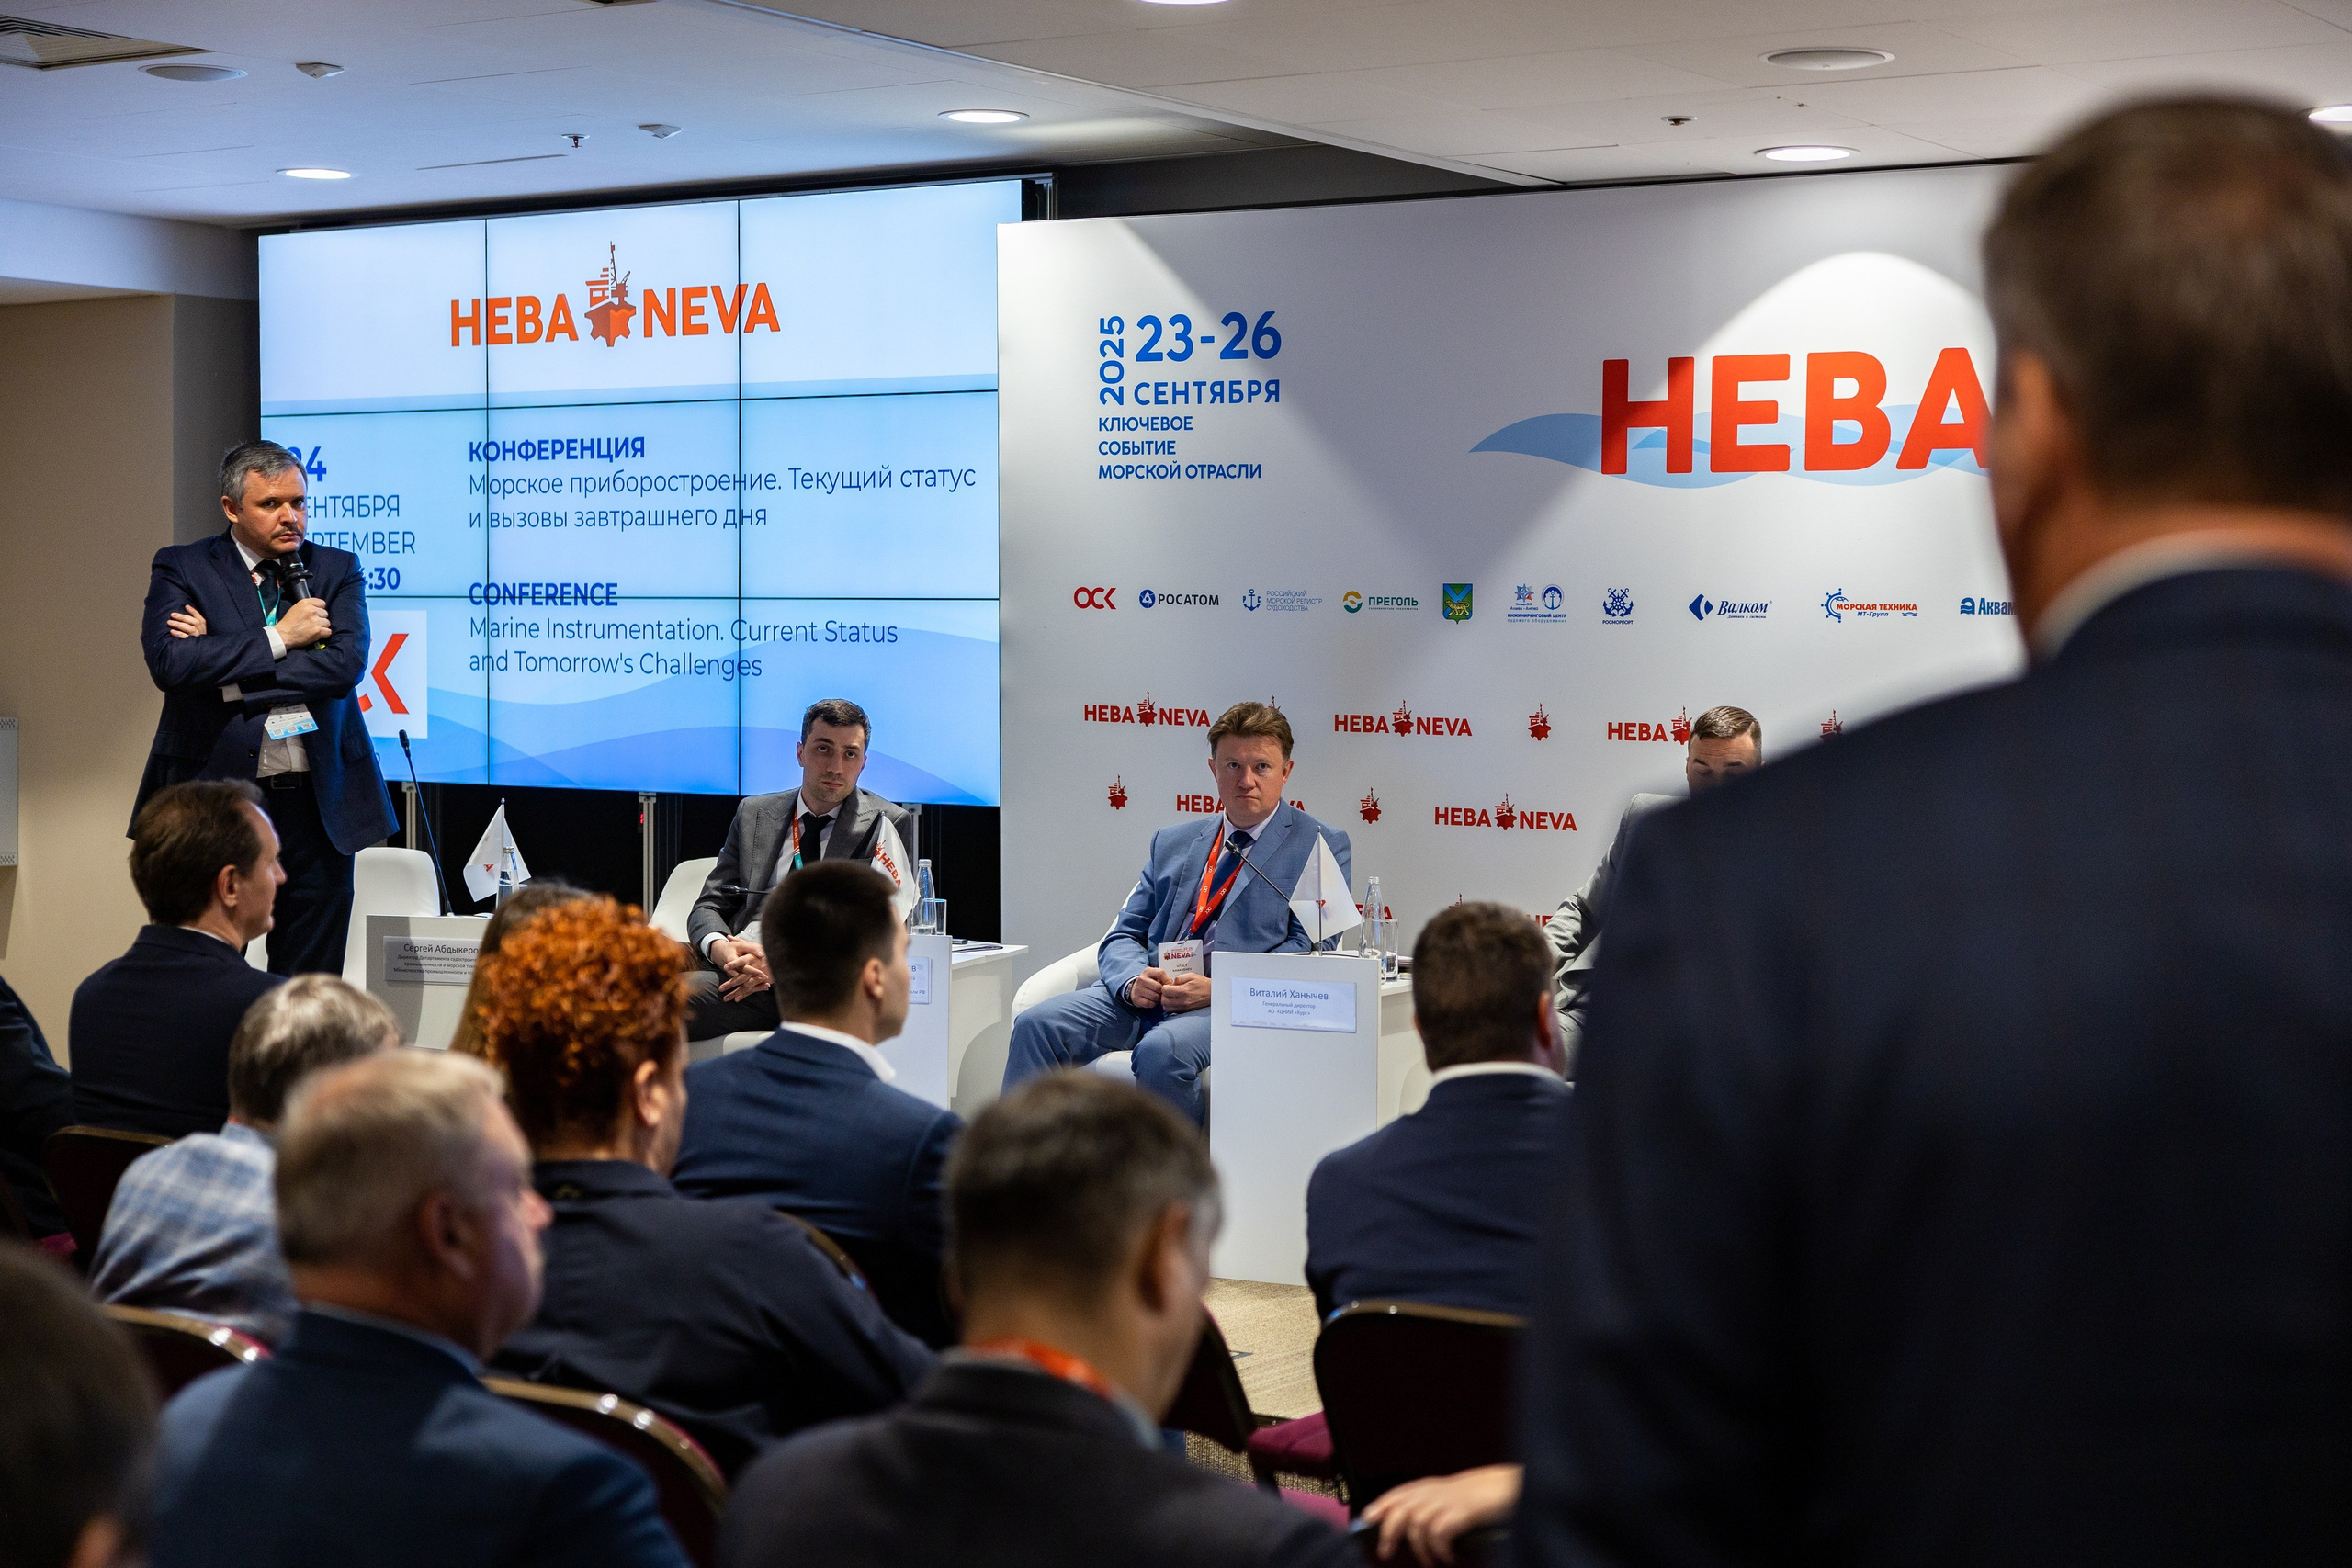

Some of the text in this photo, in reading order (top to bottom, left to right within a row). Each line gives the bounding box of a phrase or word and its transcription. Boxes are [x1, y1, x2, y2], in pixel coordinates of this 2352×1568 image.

[643, 283, 781, 338] NEVA
[1136, 310, 1282, 362] 23-26
[1099, 315, 1125, 406] 2025
[1134, 379, 1280, 406] СЕНТЯБРЯ
[1099, 416, 1193, 432] КЛЮЧЕВОЕ
[469, 436, 645, 463] КОНФЕРЕНЦИЯ
[1098, 440, 1176, 456] СОБЫТИЕ
[1098, 460, 1261, 479] МОРСКОЙ ОТРАСЛИ
[469, 464, 976, 500] Морское приборостроение. Текущий статус
[469, 508, 767, 532] и вызовы завтрашнего дня
[469, 582, 618, 606] CONFERENCE
[1158, 593, 1219, 606] РОСАТОМ
[1368, 596, 1419, 607] ПРЕГОЛЬ
[1836, 603, 1877, 611] МОРСКАЯ
[469, 616, 899, 643] Marine Instrumentation. Current Status
[469, 649, 763, 682] and Tomorrow's Challenges
[1159, 707, 1211, 728] NEVA
[1416, 716, 1473, 737] NEVA
[1520, 810, 1578, 831] NEVA
[403, 943, 479, 956] Сергей Абдыкеро
[1170, 952, 1191, 960] NEVA
[1250, 987, 1329, 1000] Виталий Ханычев
